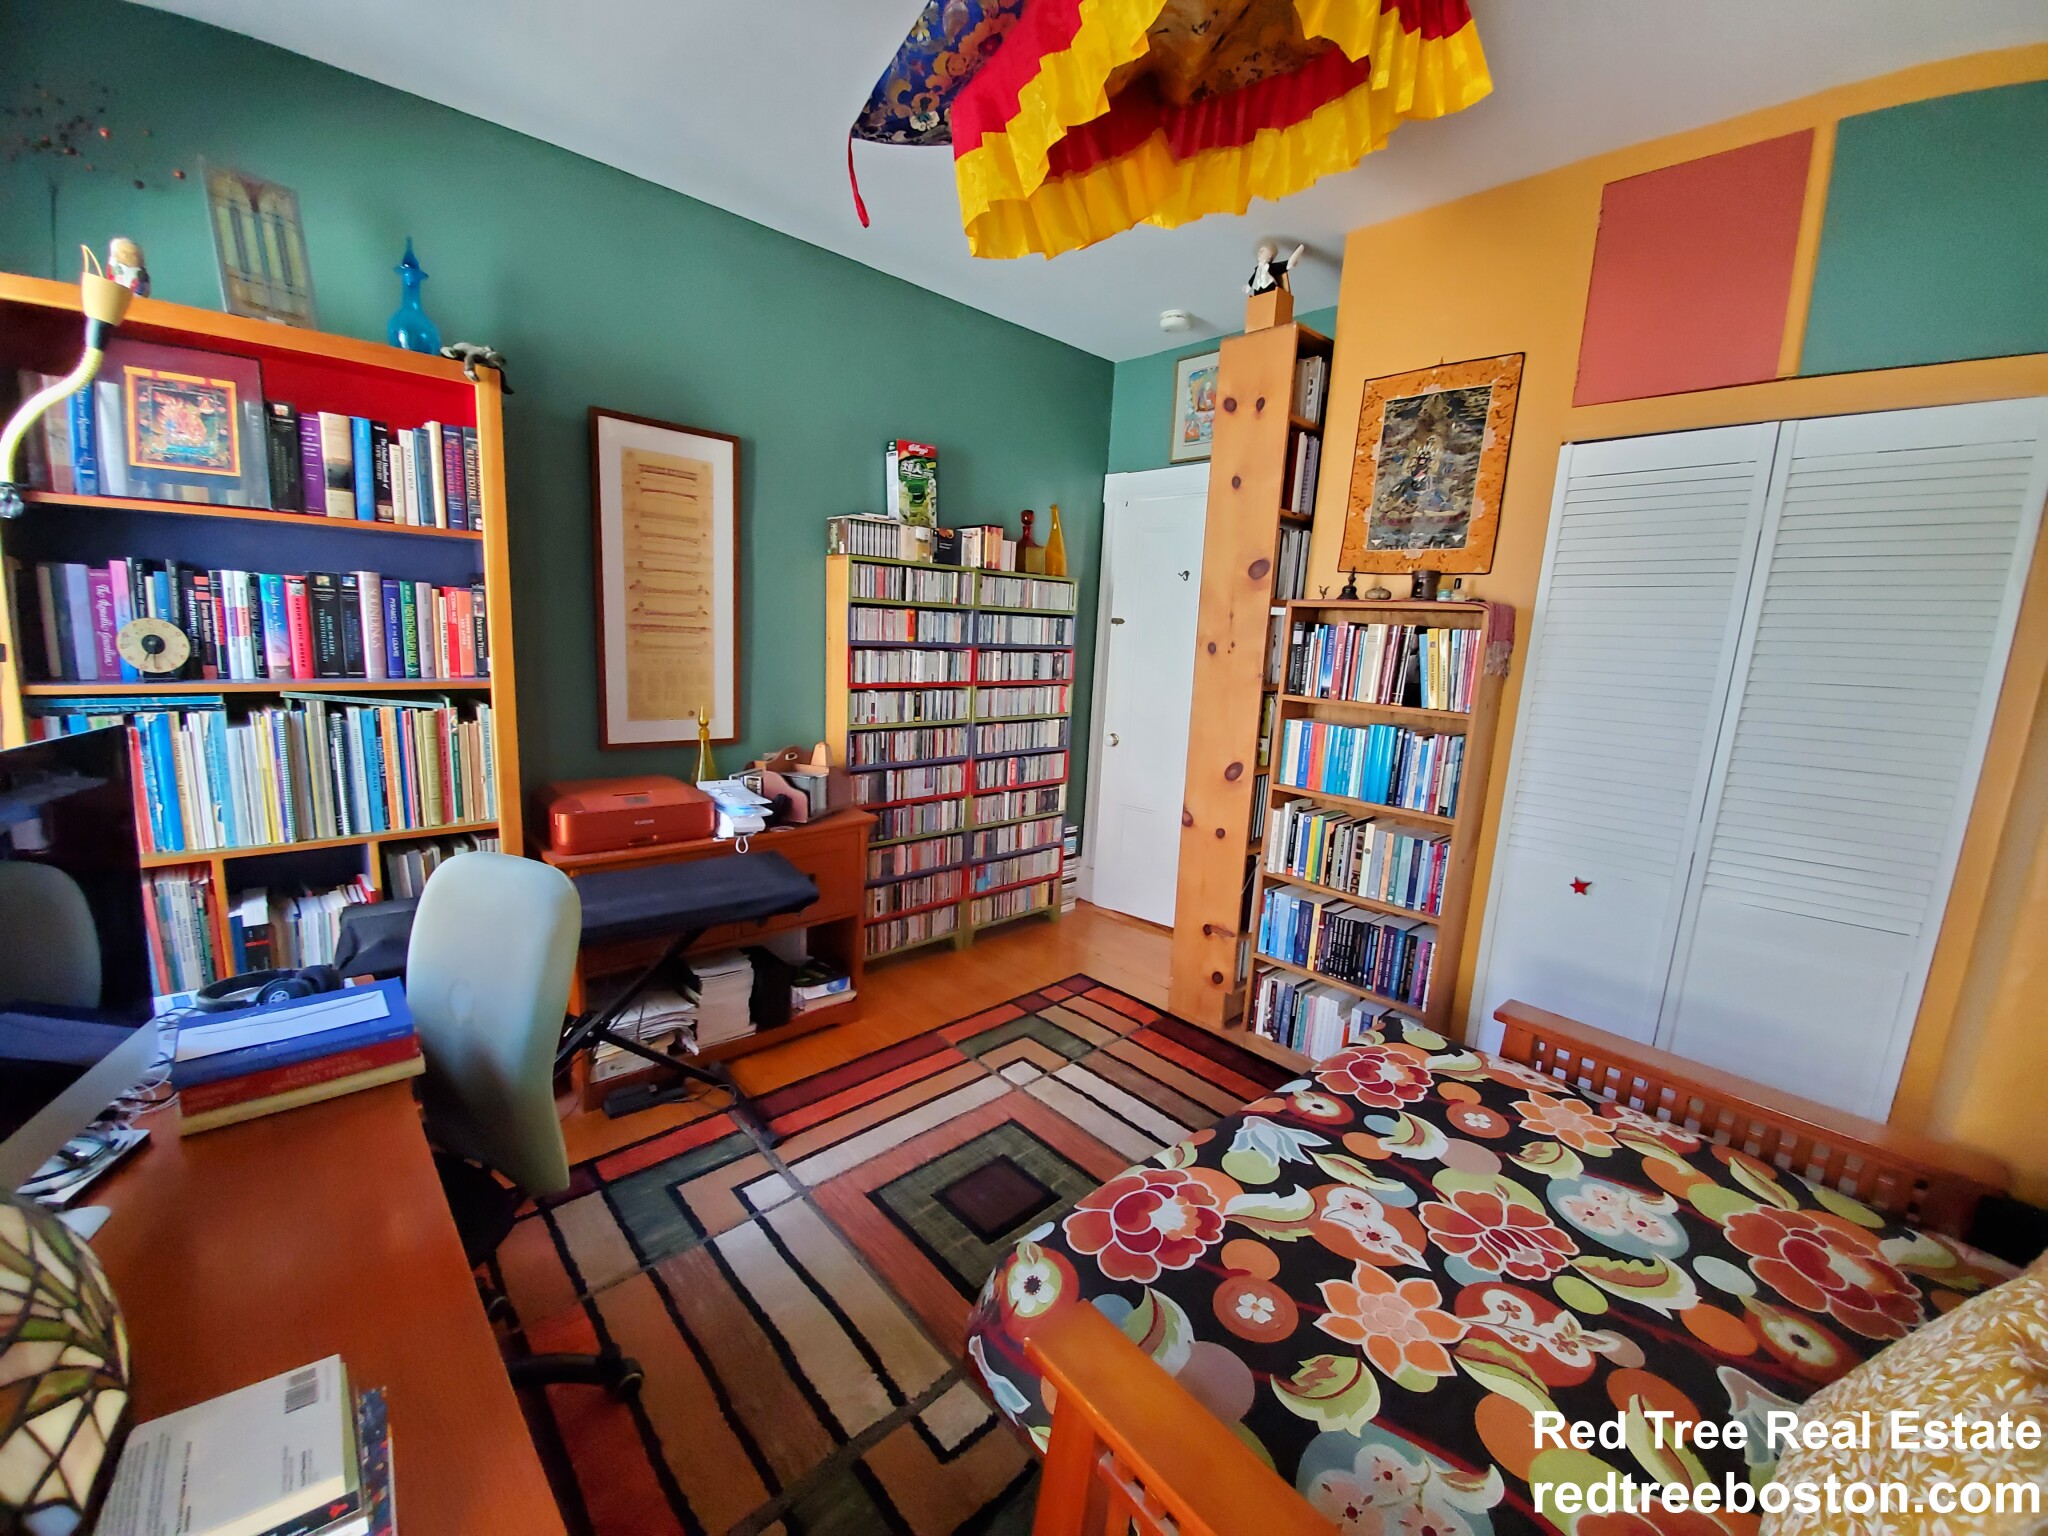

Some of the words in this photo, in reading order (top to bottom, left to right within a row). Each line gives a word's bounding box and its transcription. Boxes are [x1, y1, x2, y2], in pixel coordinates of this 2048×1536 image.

[466, 448, 477, 500] REPERTOIRE
[187, 589, 198, 627] modernism
[368, 588, 381, 648] SOUNDINGS
[389, 597, 398, 624] PYRAMIDS
[392, 637, 400, 657] LOUVRE
[376, 736, 385, 763] Symphony
